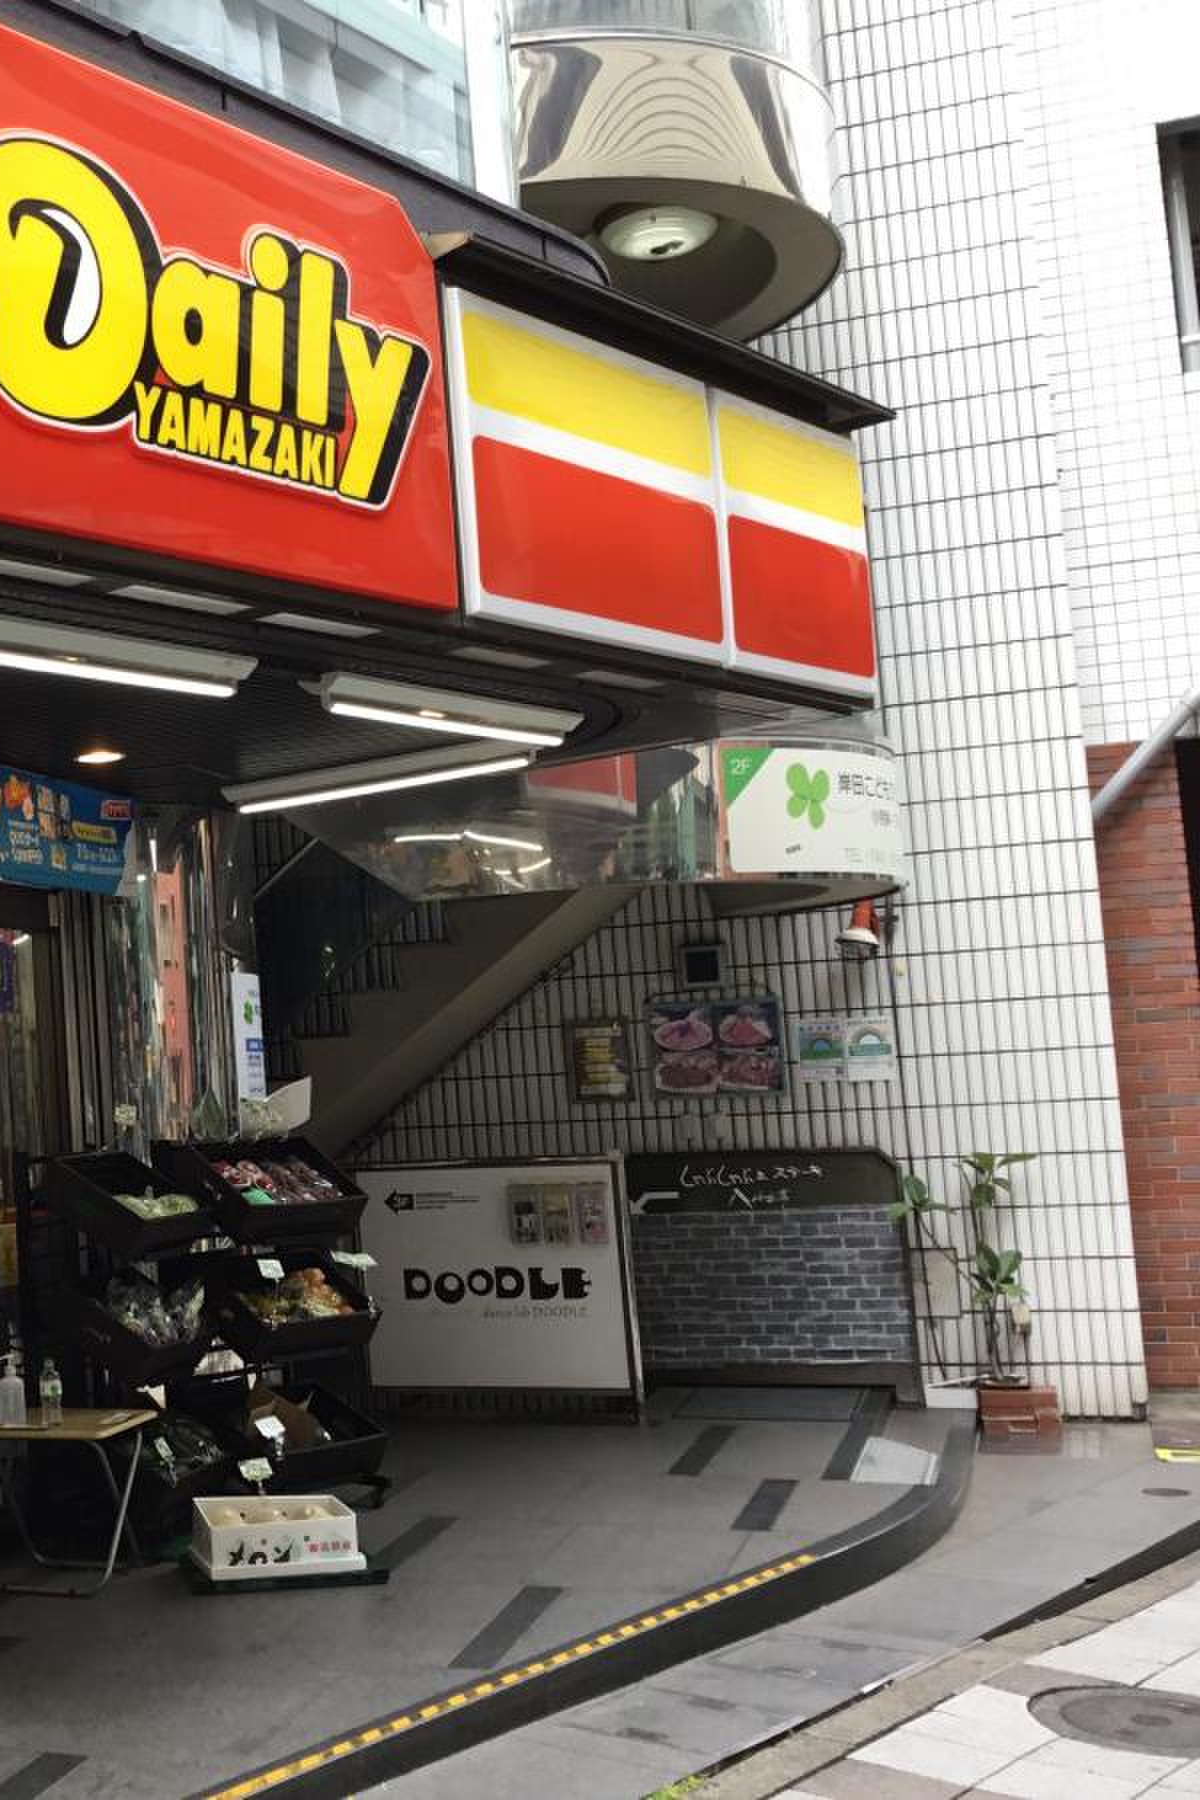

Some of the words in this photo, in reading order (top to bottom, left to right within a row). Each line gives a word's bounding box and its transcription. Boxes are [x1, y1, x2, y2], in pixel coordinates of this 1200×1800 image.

[133, 380, 341, 492] YAMAZAKI
[730, 758, 753, 776] 2F
[402, 1266, 593, 1305] DOODLE
